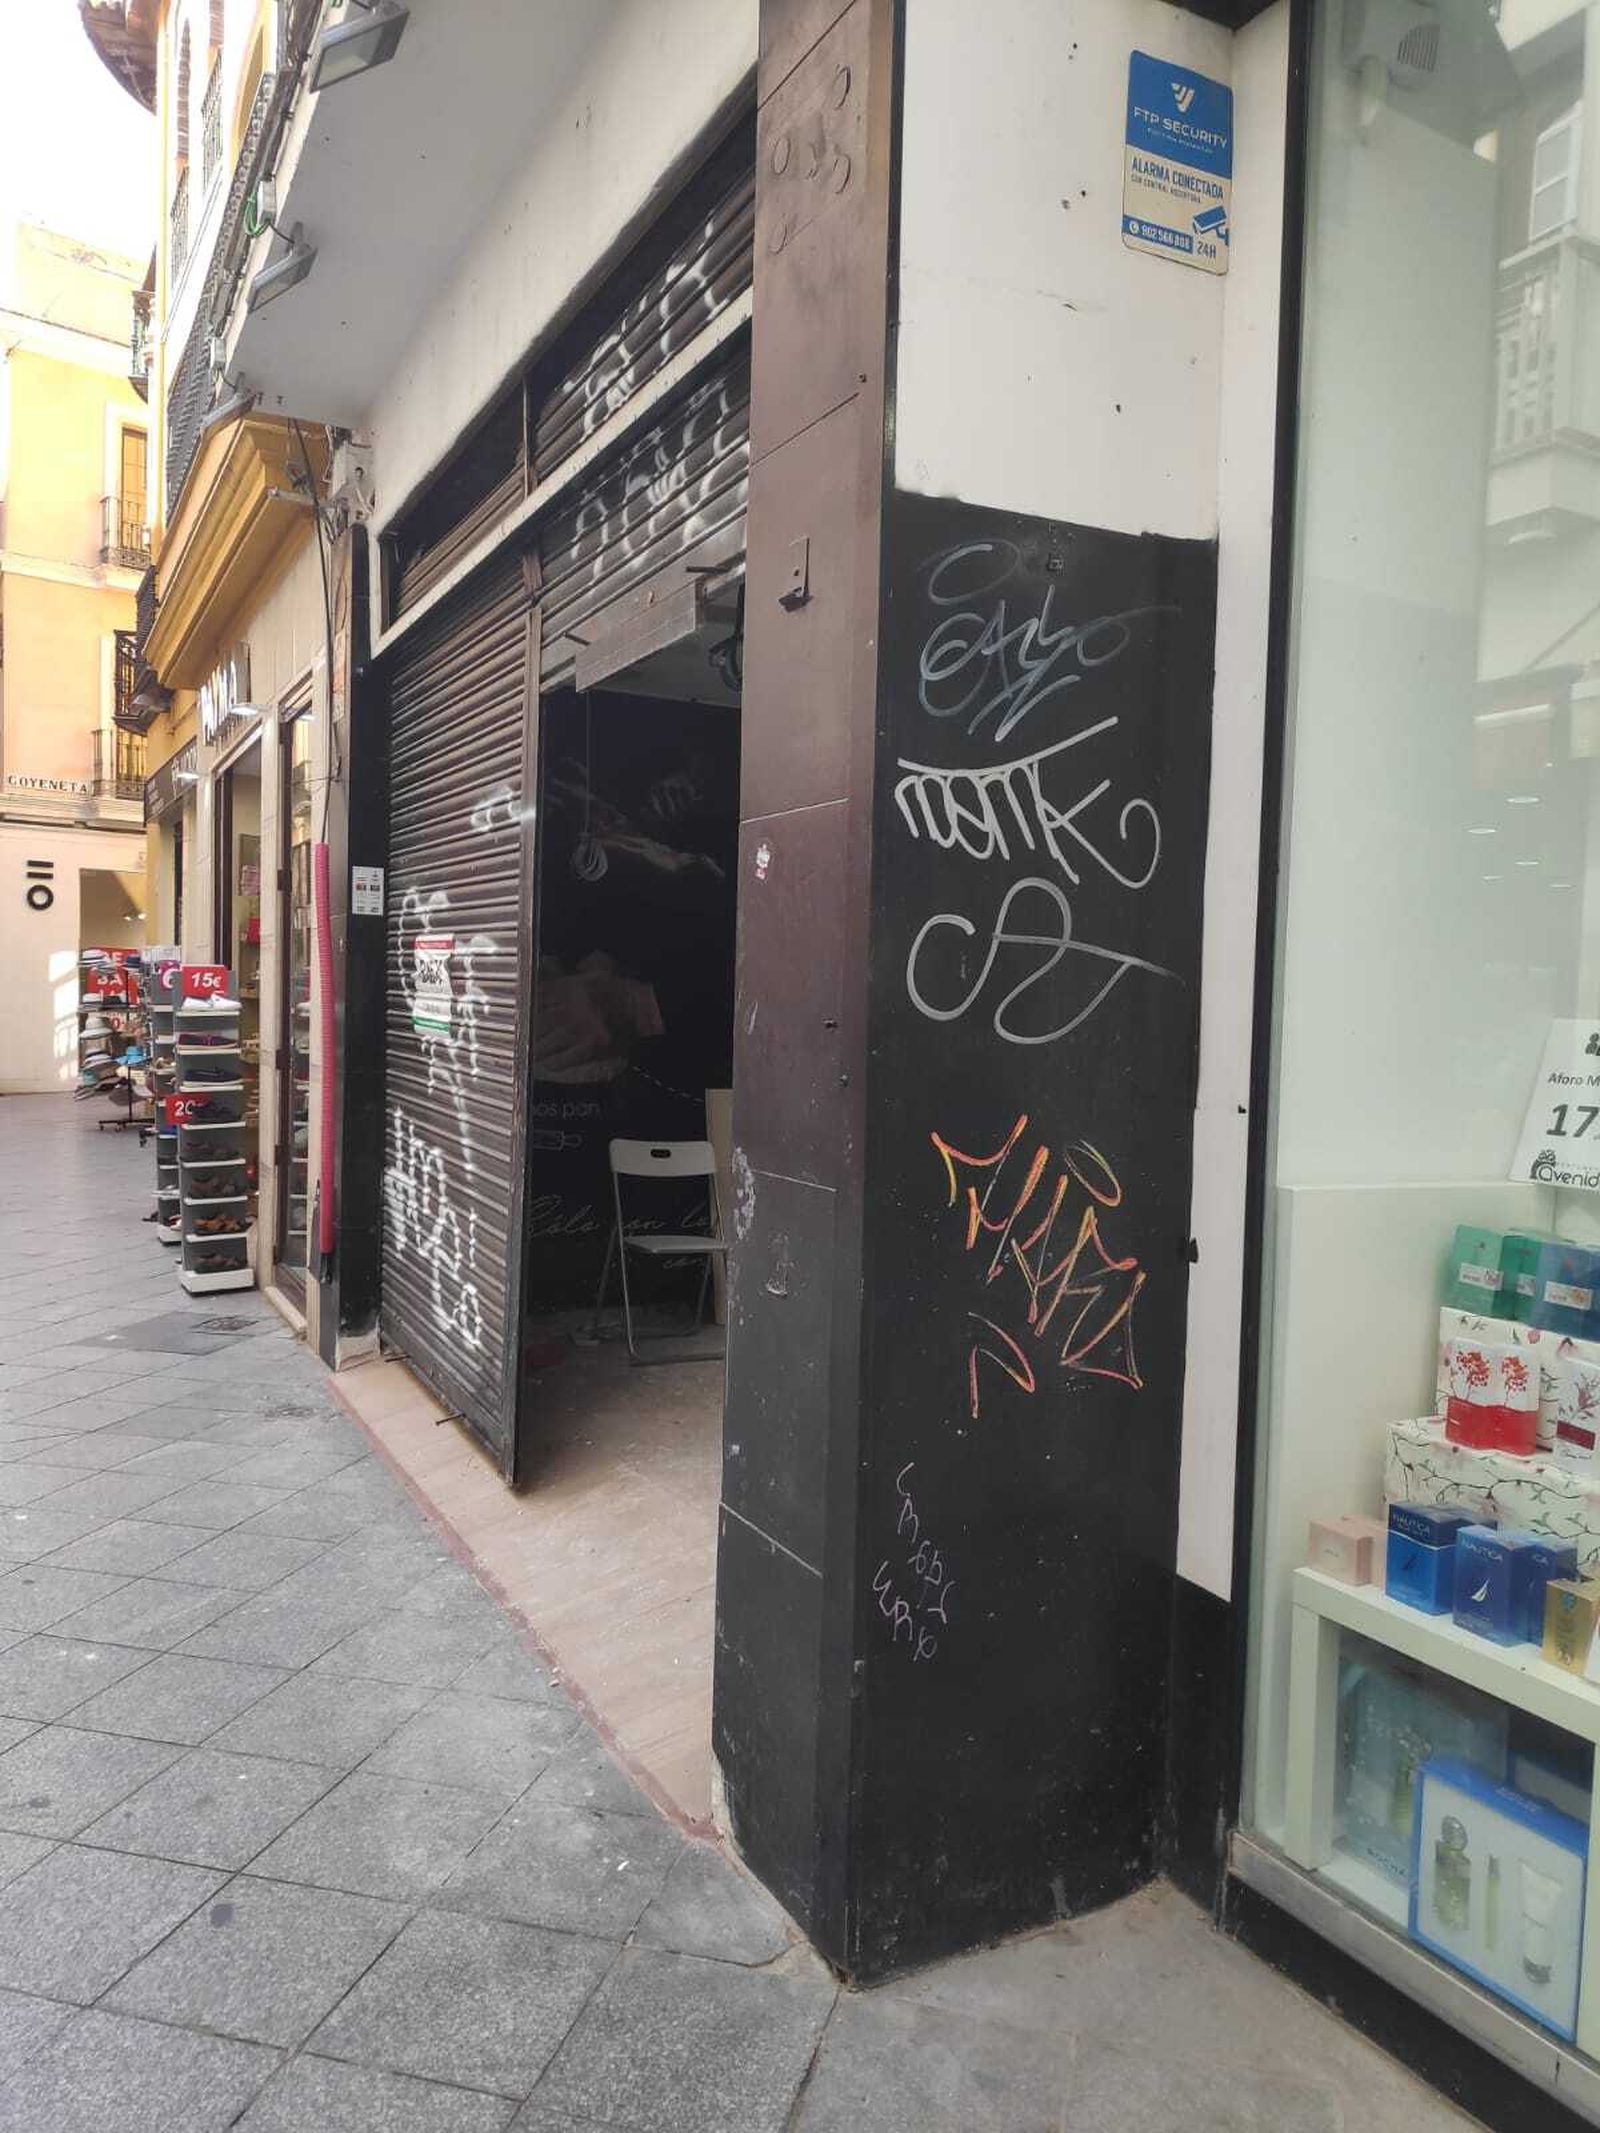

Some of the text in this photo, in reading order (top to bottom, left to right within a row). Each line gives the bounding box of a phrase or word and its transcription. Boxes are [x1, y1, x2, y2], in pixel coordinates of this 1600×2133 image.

[1133, 106, 1160, 124] FTP
[1162, 117, 1228, 149] SECURITY
[1131, 156, 1170, 182] ALARMA
[1172, 171, 1224, 199] CONECTADA
[1197, 241, 1217, 259] 24H
[8, 775, 88, 793] GOYENETA
[191, 972, 221, 989] 15€
[1547, 1071, 1583, 1086] Aforo
[1546, 1103, 1600, 1138] 17
